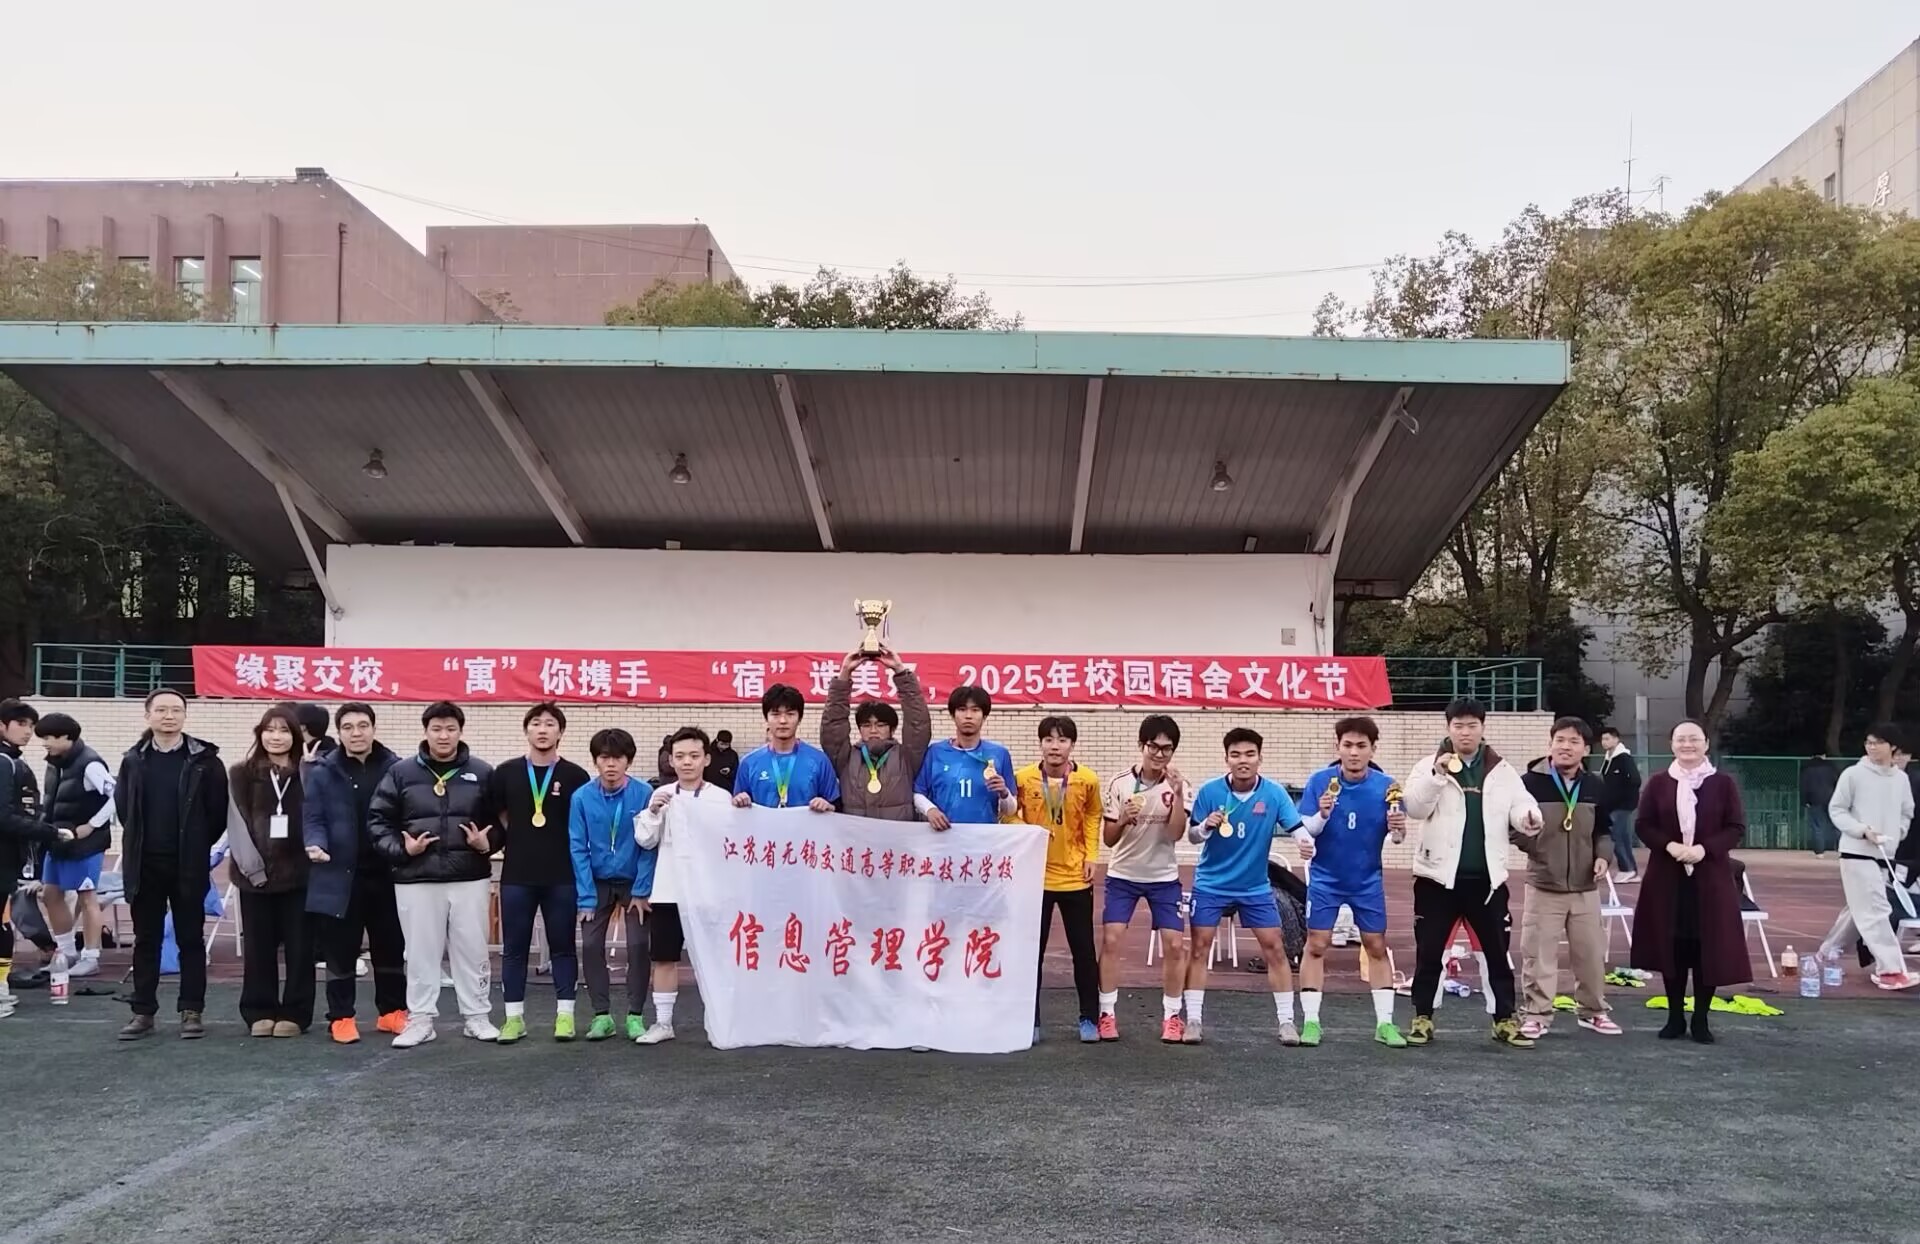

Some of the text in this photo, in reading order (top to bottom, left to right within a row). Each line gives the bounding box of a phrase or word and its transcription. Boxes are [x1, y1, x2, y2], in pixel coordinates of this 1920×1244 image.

[959, 778, 972, 798] 11
[1237, 821, 1246, 839] 8
[1347, 811, 1357, 830] 8
[722, 834, 1015, 884] 江苏省无锡交通高等职业技术学校
[728, 910, 1003, 982] 信息管理学院
